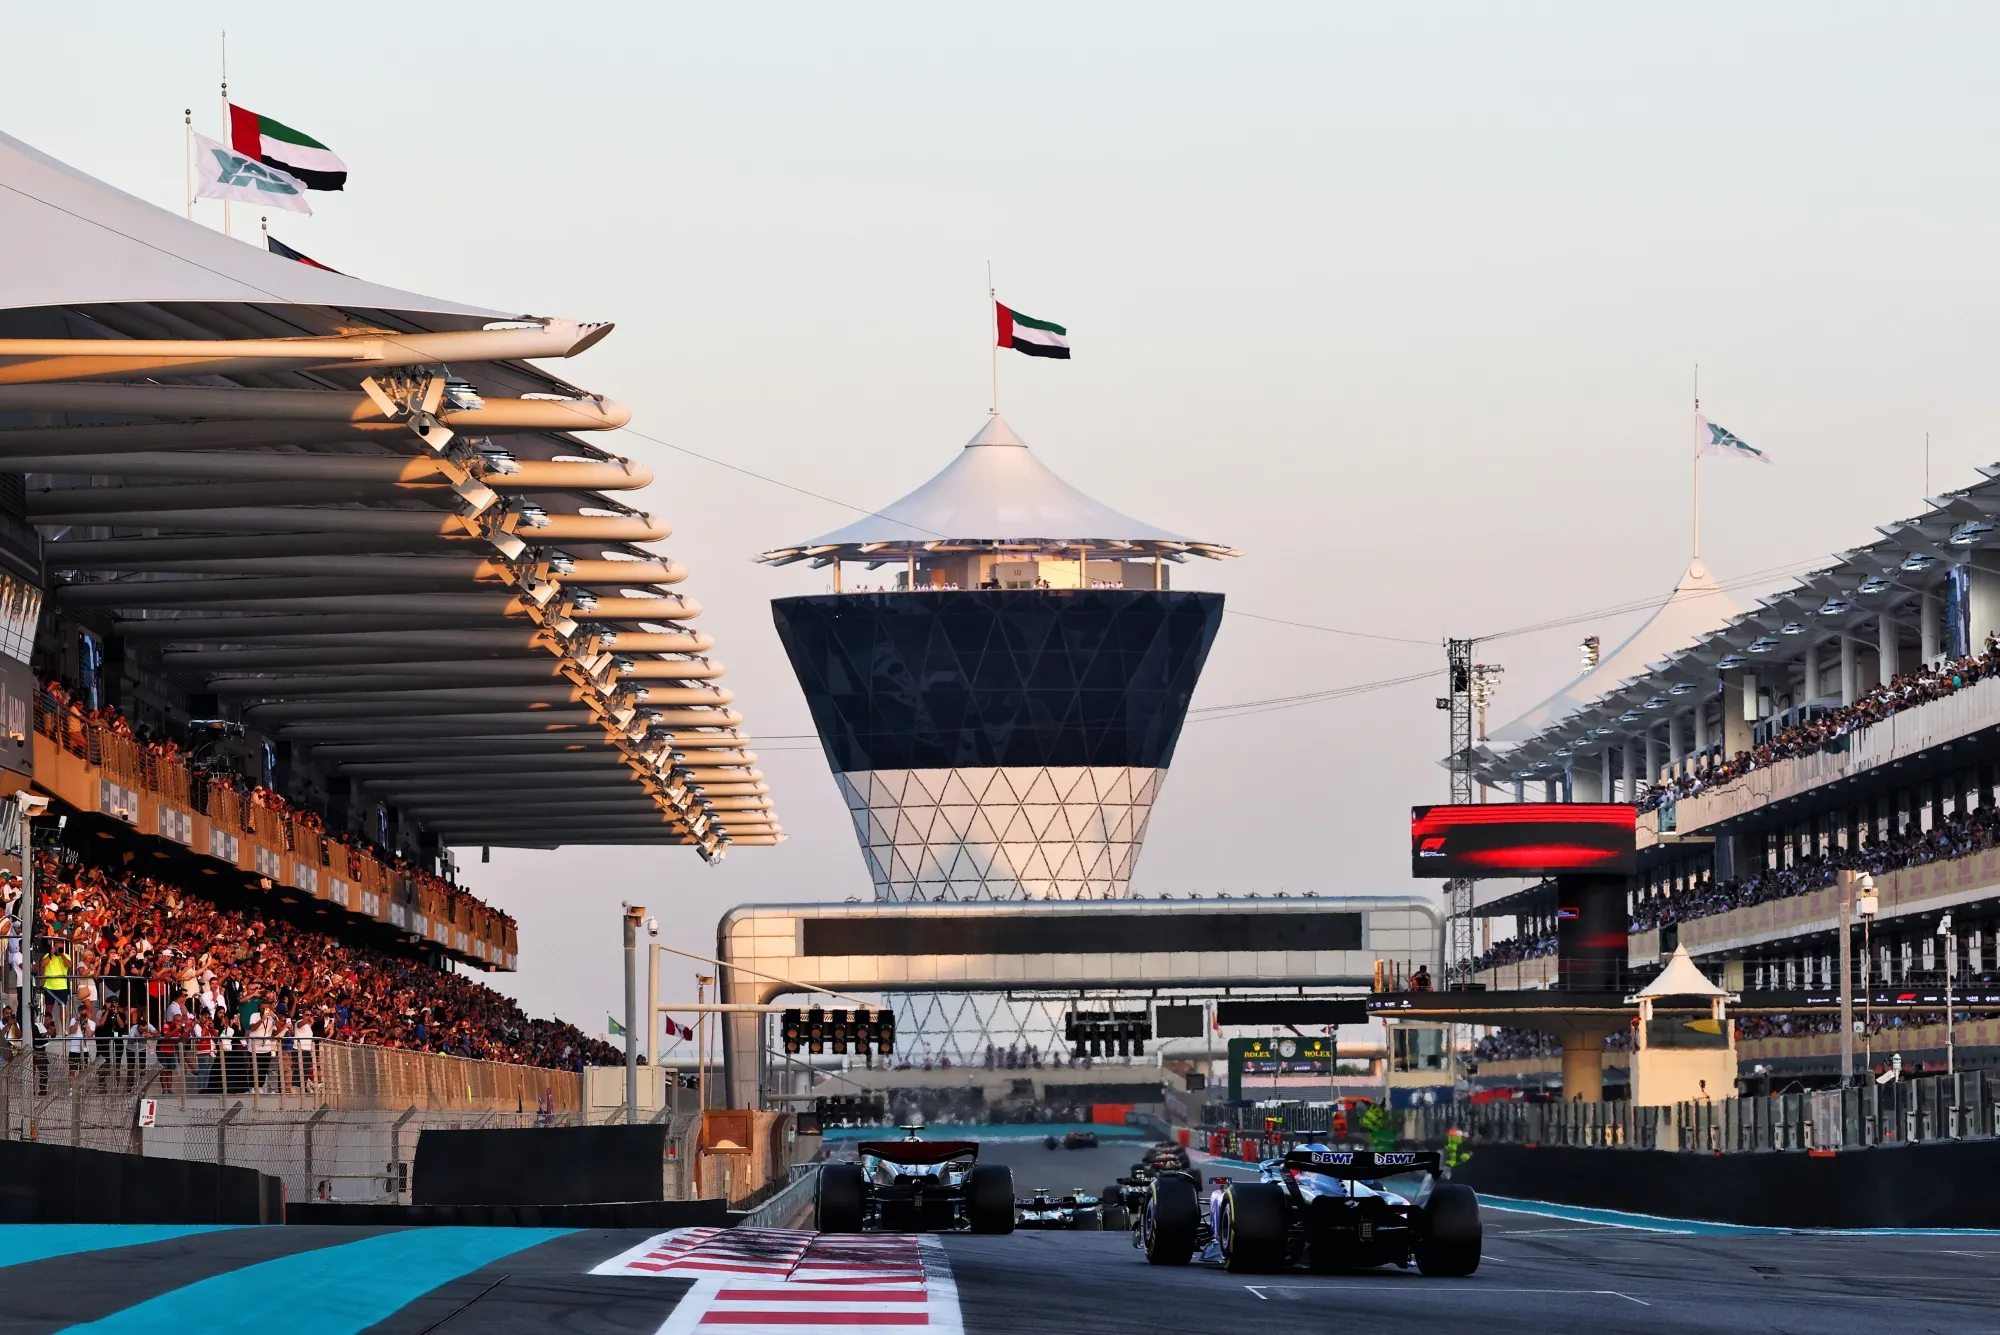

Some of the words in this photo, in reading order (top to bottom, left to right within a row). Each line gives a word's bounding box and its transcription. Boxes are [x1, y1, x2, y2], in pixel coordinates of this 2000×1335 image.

[1304, 1050, 1331, 1058] ROLEX
[1322, 1152, 1353, 1164] BWT
[1384, 1152, 1415, 1164] BWT
